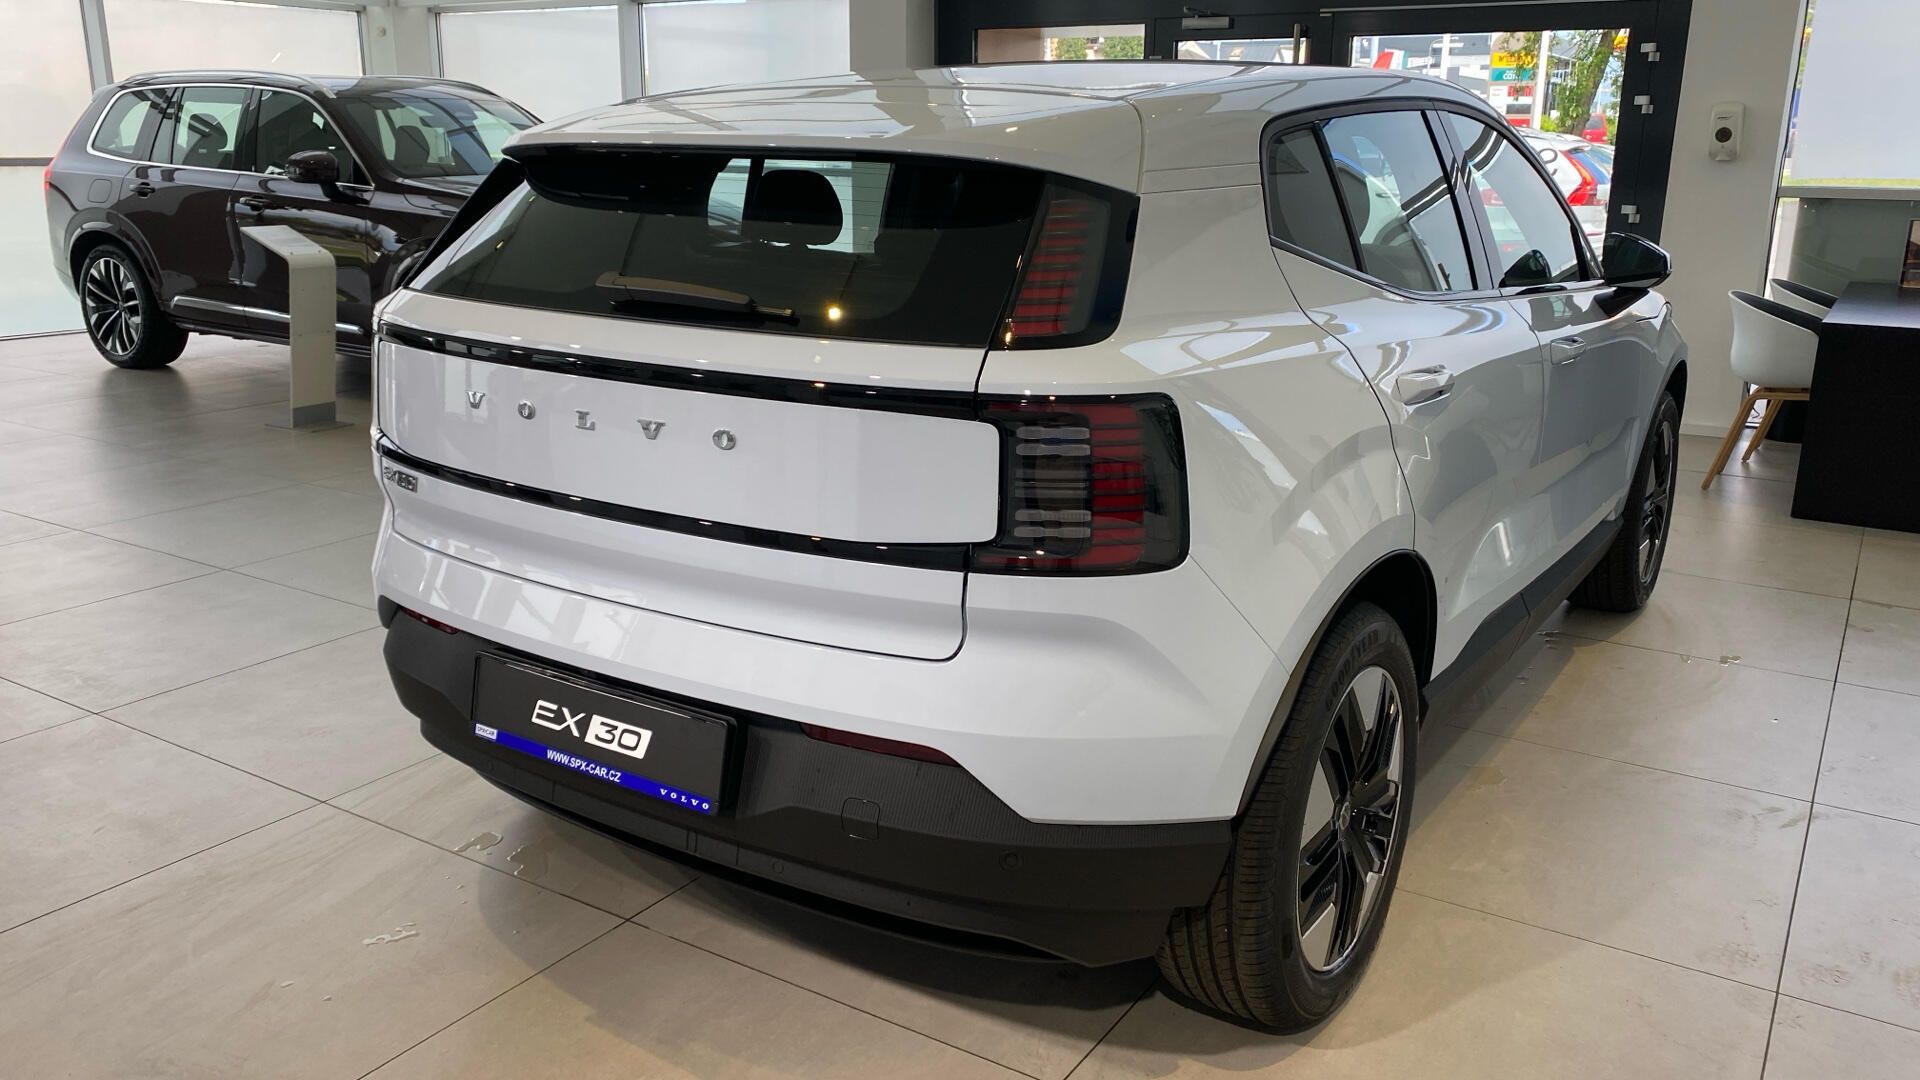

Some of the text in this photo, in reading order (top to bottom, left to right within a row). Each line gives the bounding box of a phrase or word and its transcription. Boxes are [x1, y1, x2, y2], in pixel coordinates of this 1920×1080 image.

[466, 391, 737, 451] VOLVO
[546, 749, 622, 783] WWW.SPX-CAR.CZ
[659, 787, 710, 810] VOLVO
